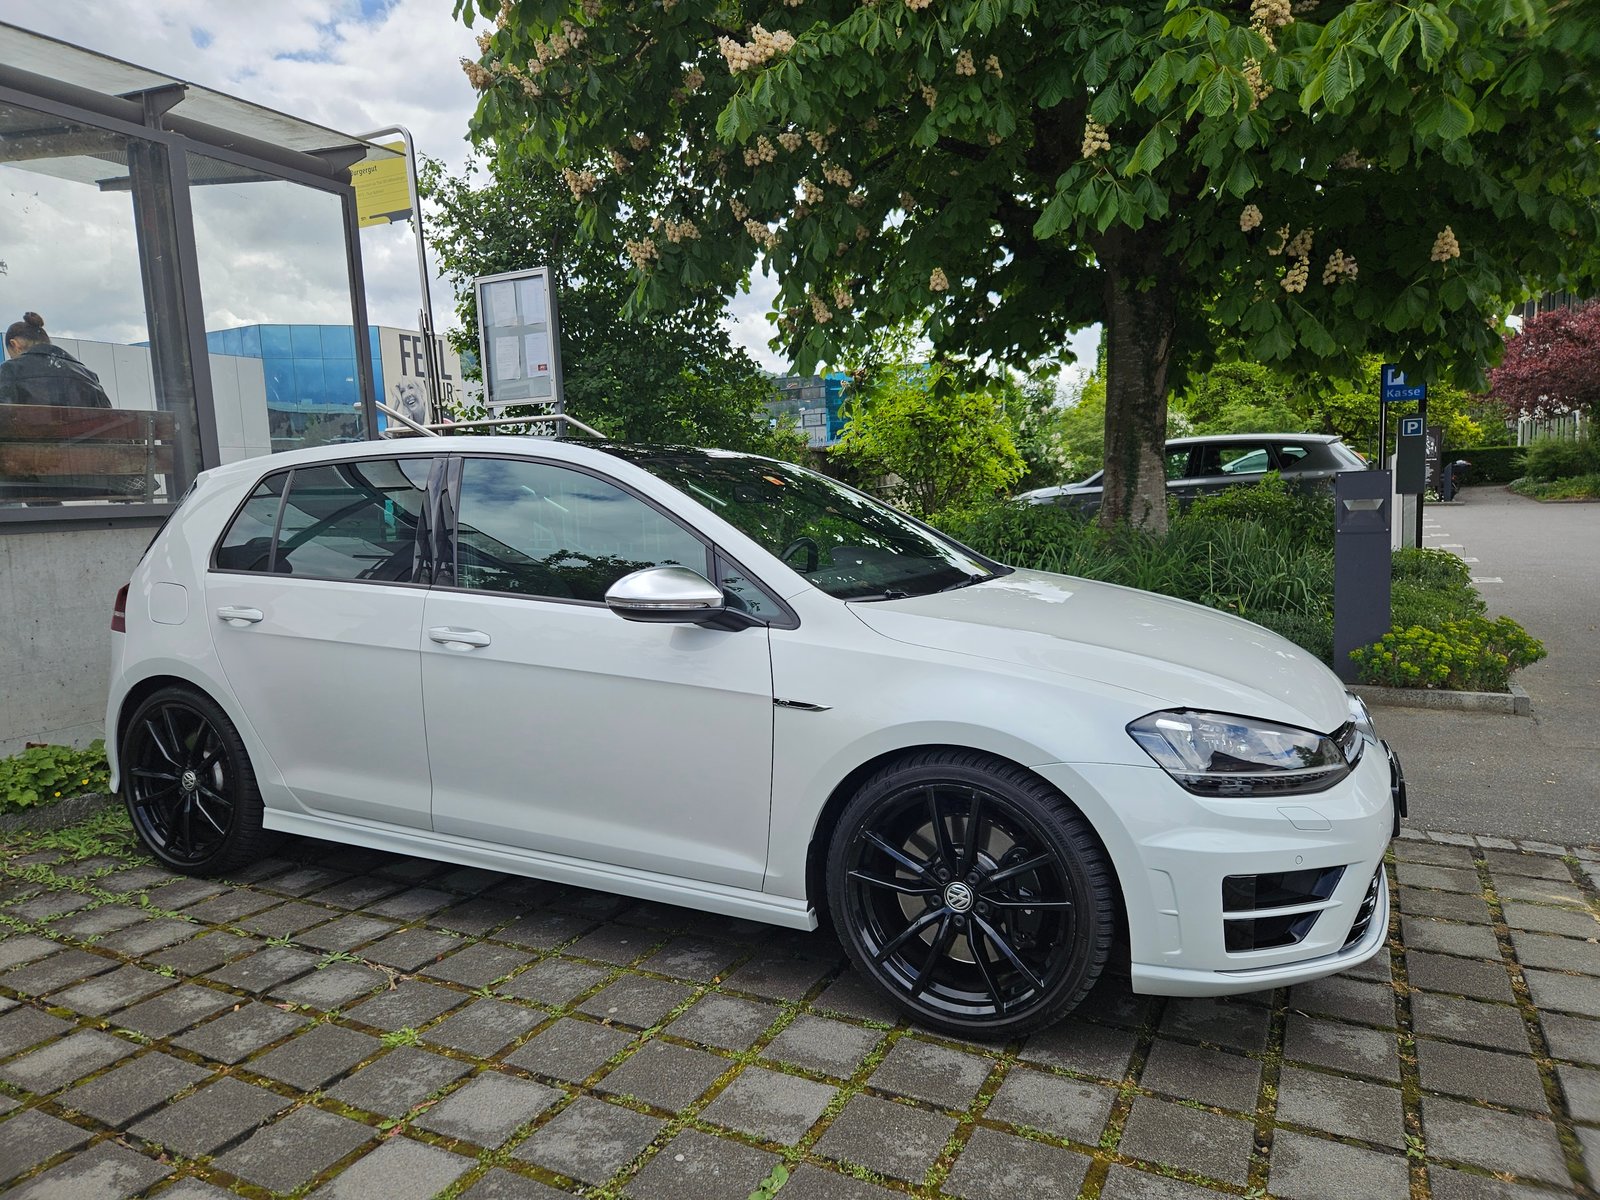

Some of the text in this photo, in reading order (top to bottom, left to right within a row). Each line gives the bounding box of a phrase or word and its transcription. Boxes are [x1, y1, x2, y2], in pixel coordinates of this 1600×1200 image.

[399, 334, 452, 380] FEL
[1386, 388, 1420, 398] Kasse
[1407, 421, 1419, 434] P
